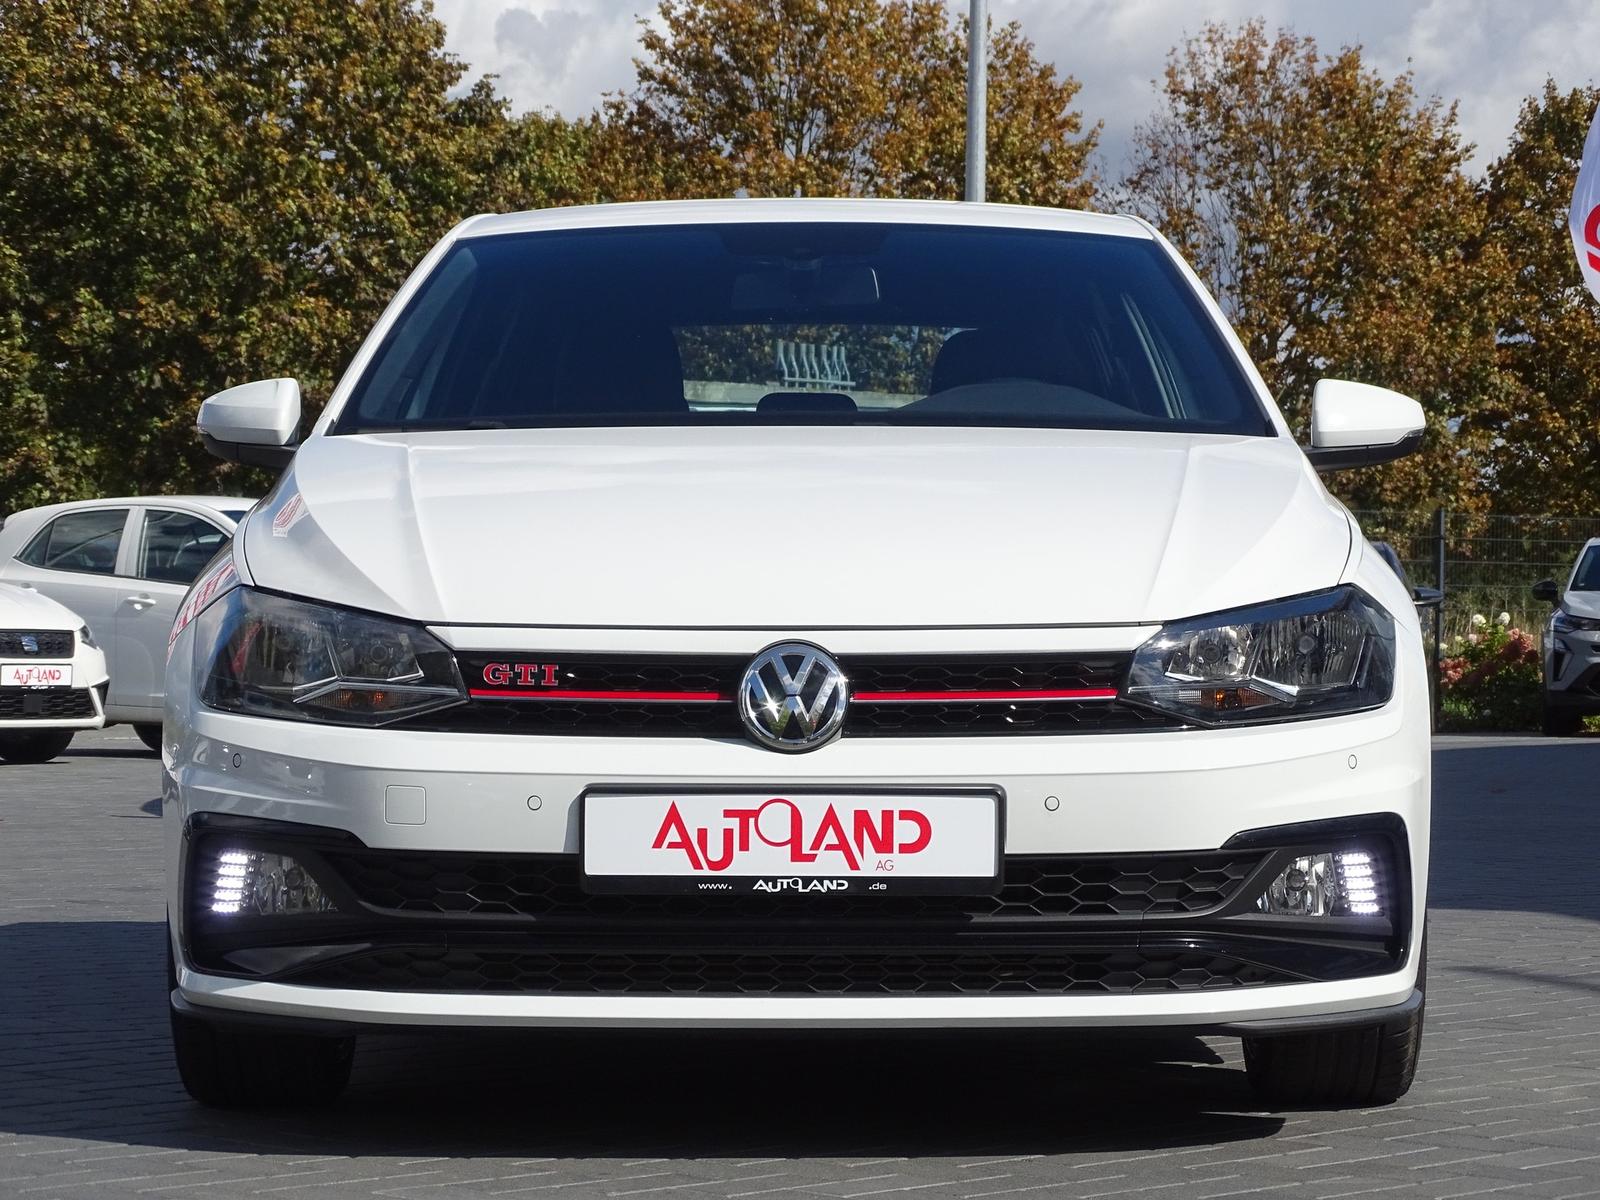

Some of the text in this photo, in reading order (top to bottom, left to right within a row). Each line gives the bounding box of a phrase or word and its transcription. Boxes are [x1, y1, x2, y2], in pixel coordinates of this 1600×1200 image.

[13, 666, 62, 685] AUTOLAND
[483, 663, 559, 686] GTI
[651, 798, 932, 872] AUTOLAND
[875, 859, 895, 872] AG
[752, 877, 849, 893] AUTOLAND
[868, 882, 887, 890] .de
